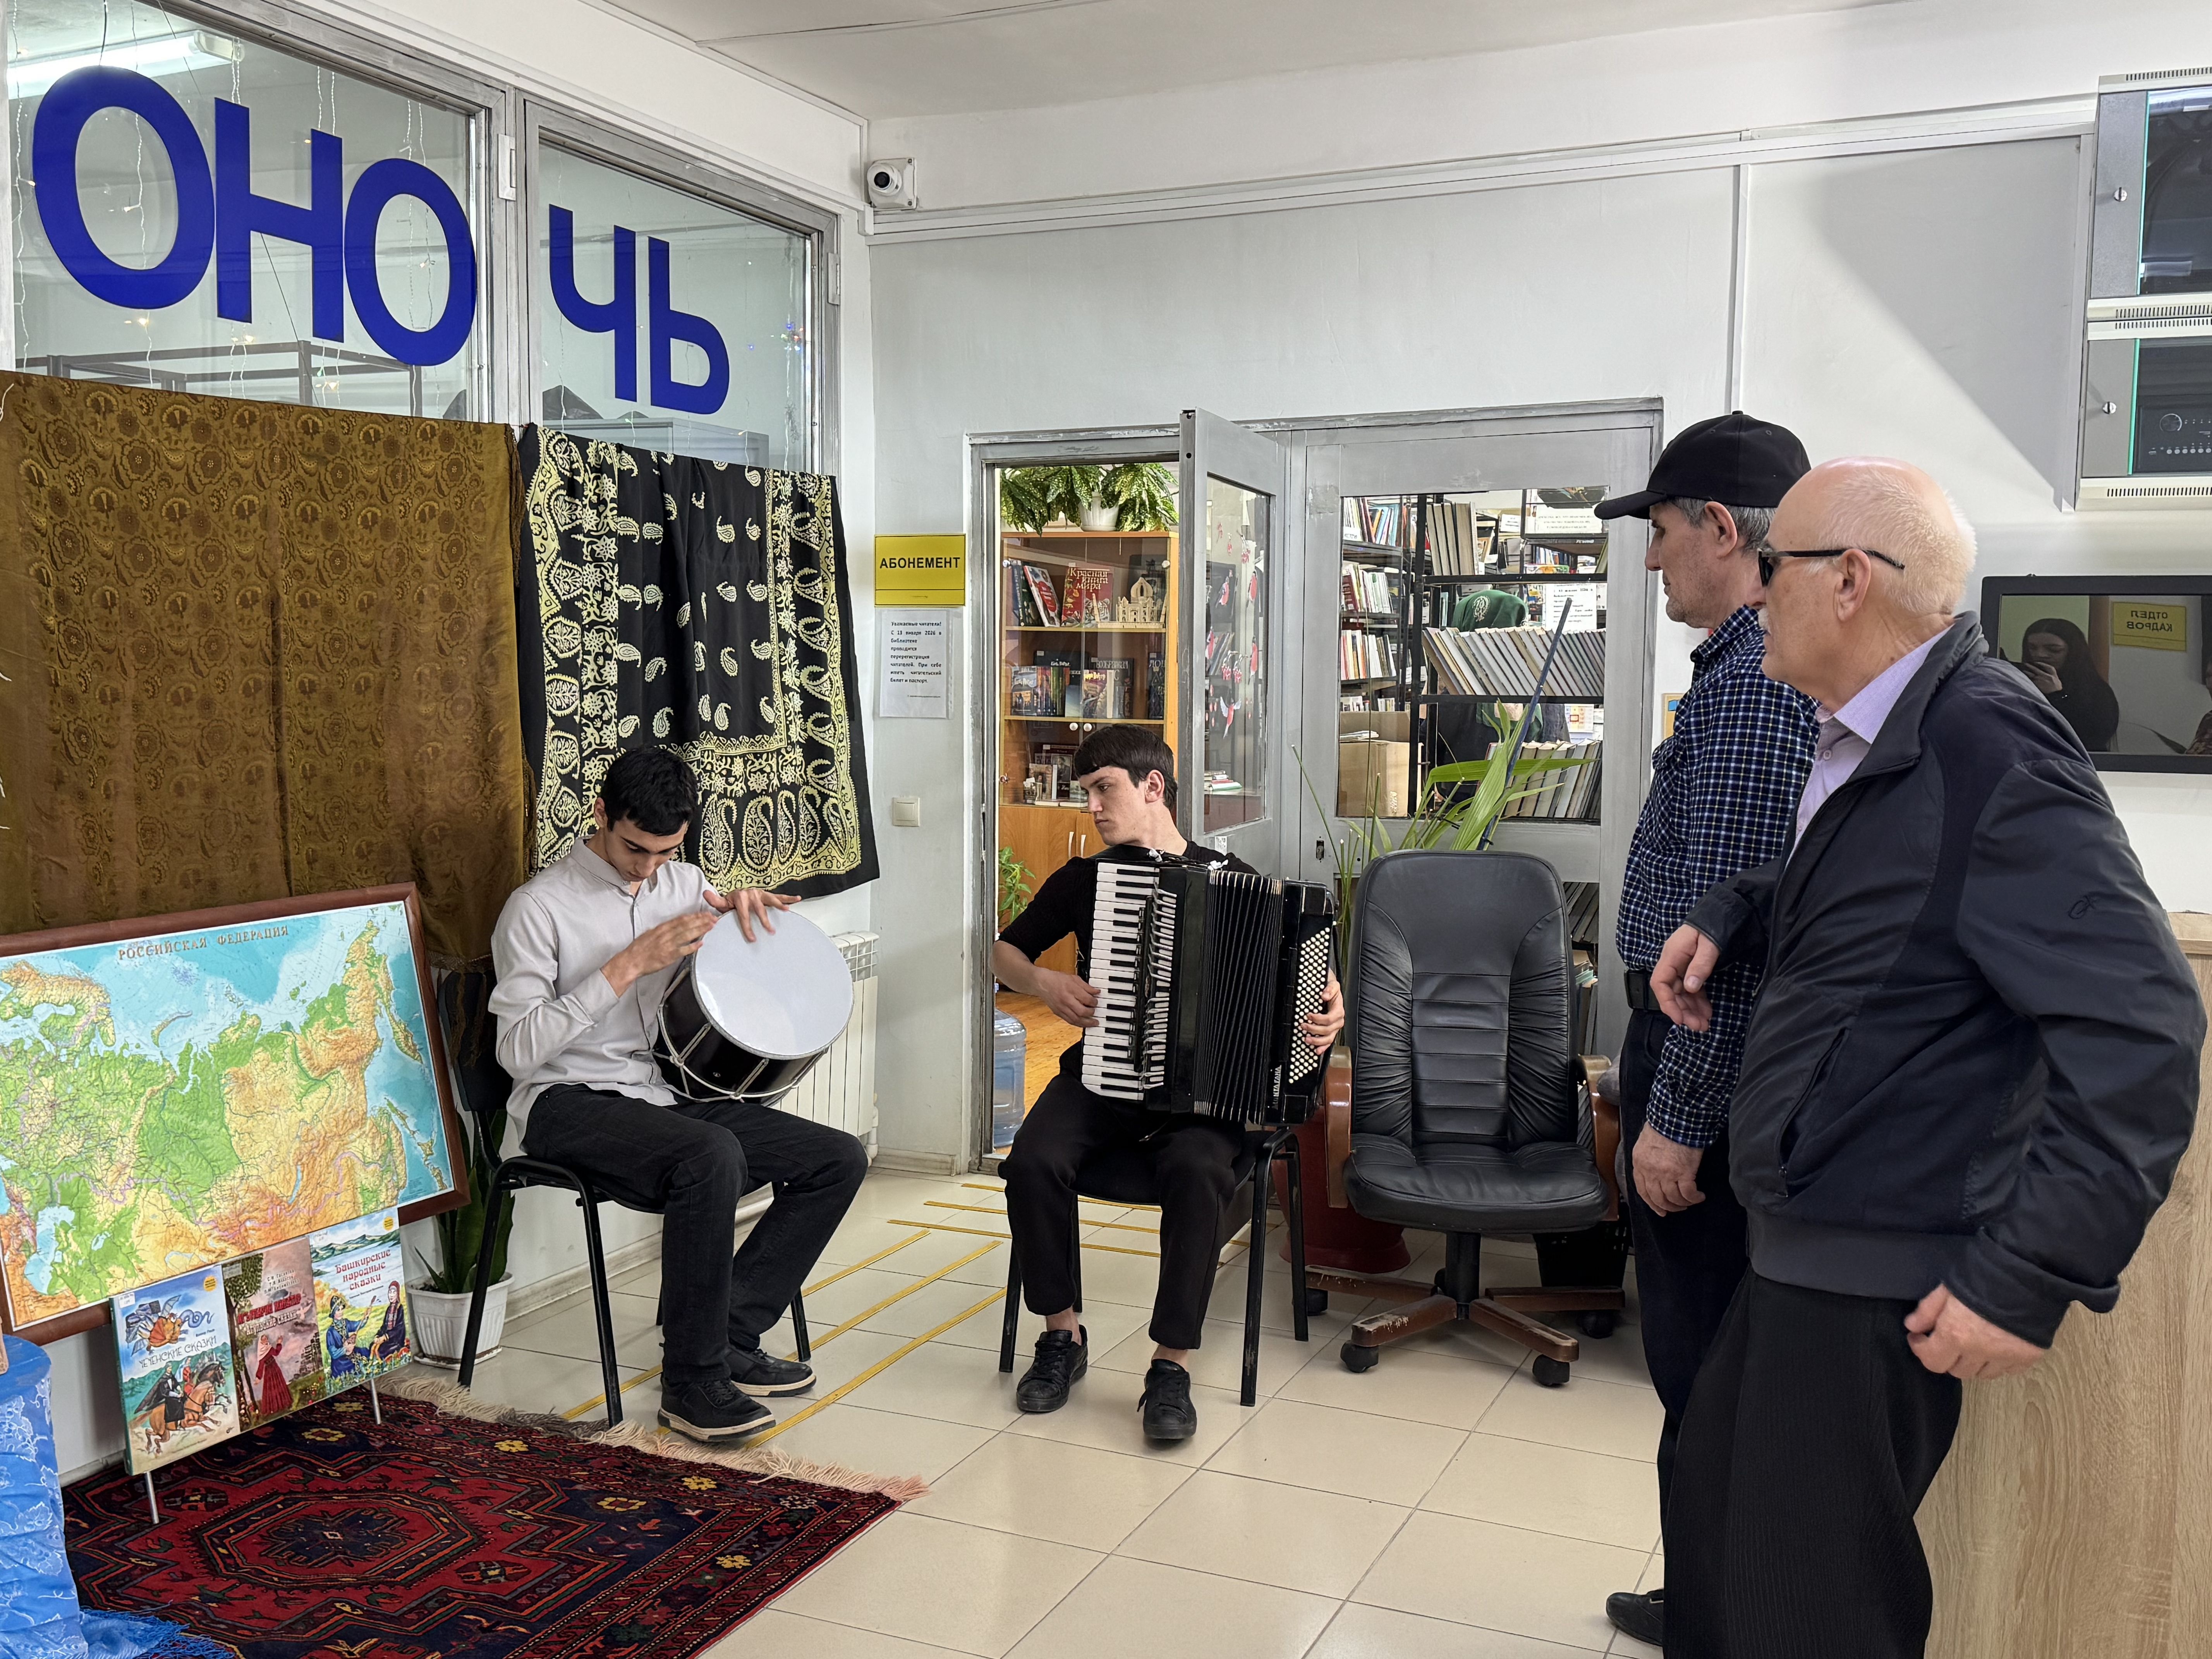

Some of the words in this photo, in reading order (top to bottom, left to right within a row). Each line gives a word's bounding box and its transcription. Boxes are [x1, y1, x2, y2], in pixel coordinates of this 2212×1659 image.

[879, 557, 960, 568] АБОНЕМЕНТ
[1070, 567, 1108, 579] Красная
[1076, 582, 1101, 592] мира
[118, 937, 207, 960] РОССИЙСКАЯ
[216, 925, 288, 945] ФЕДЕРАЦИЯ
[335, 1249, 391, 1274] Башкирские
[343, 1262, 386, 1282] народные
[350, 1274, 381, 1290] сказки
[246, 1317, 276, 1335] Агульские
[277, 1311, 298, 1324] сказки
[184, 1336, 217, 1353] СКАЗКИ
